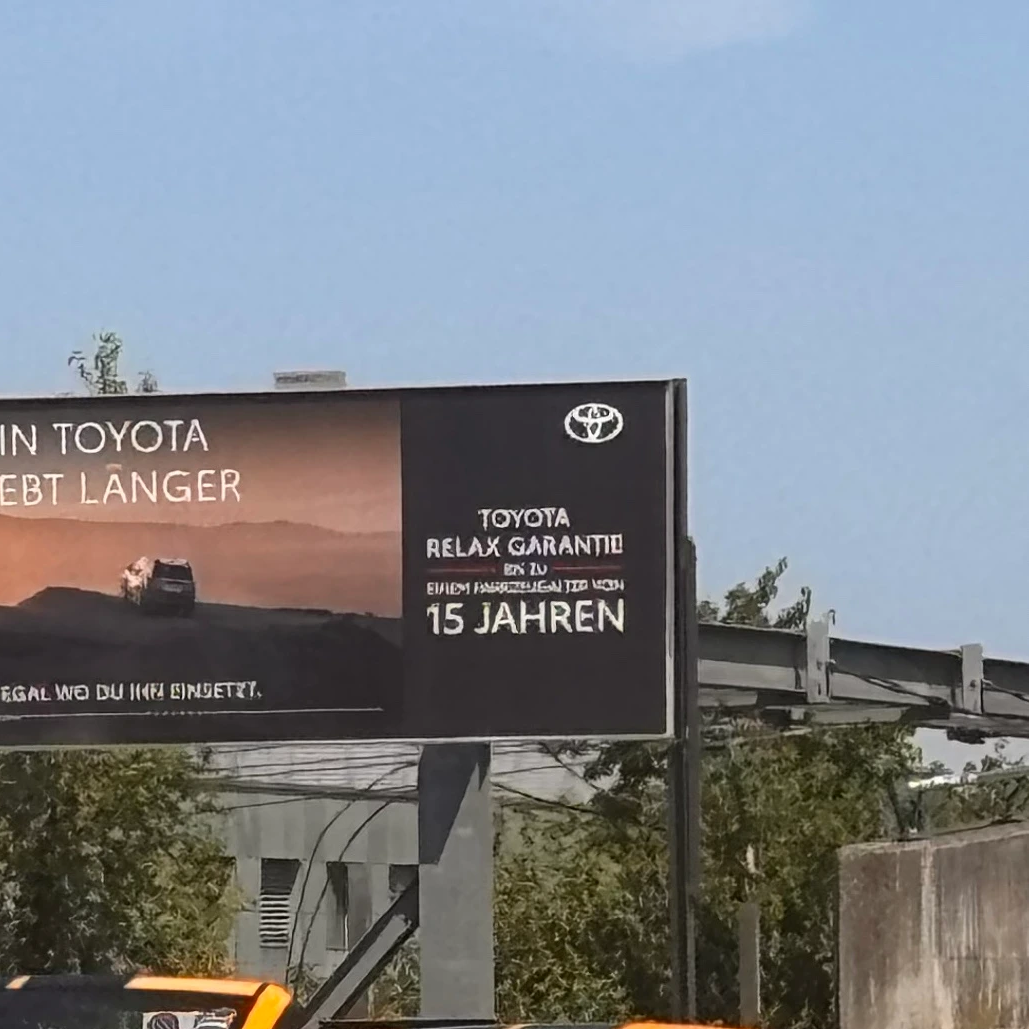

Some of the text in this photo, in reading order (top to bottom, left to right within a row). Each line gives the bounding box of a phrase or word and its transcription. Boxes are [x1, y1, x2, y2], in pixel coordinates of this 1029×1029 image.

[52, 419, 209, 455] TOYOTA
[478, 507, 571, 530] TOYOTA
[427, 536, 501, 558] RELAX
[427, 598, 625, 635] 15 JAHREN
[96, 683, 124, 701] DU
